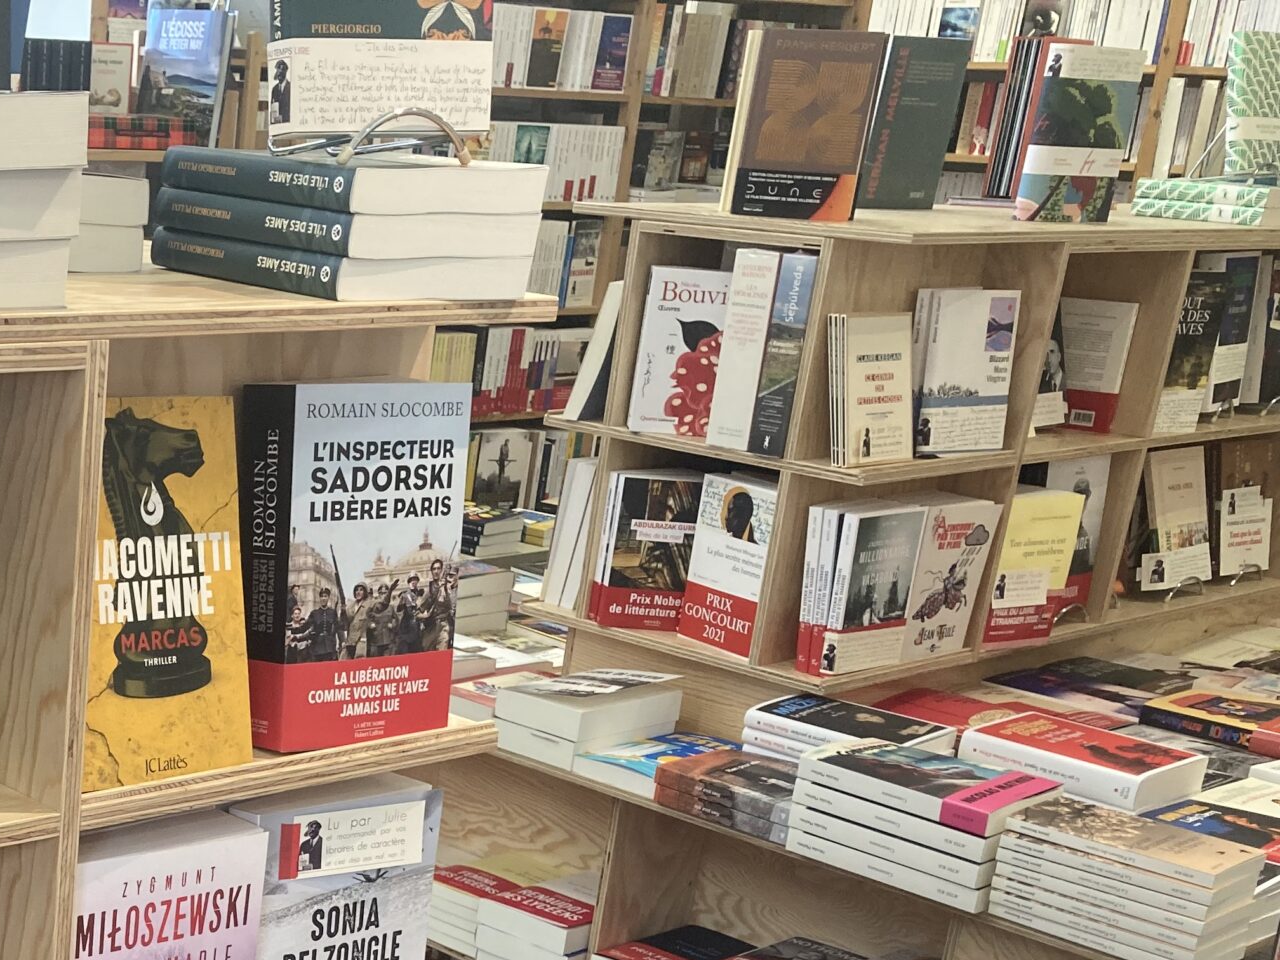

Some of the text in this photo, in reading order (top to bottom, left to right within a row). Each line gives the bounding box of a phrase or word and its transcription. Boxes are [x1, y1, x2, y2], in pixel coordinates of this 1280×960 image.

[311, 24, 382, 34] PIERGIORGIO
[866, 47, 910, 199] HERMAN MELVILLE
[269, 170, 291, 186] ÂMES
[292, 173, 309, 186] DES
[661, 281, 729, 306] Bouvi
[307, 402, 464, 419] ROMAIN SLOCOMBE
[313, 439, 455, 462] L'INSPECTEUR
[265, 429, 279, 549] SLOCOMBE
[310, 464, 454, 494] SADORSKI
[252, 460, 264, 548] ROMAIN
[309, 494, 452, 523] LIBÈRE PARIS
[94, 531, 232, 581] ACOMETTI
[97, 576, 215, 625] RAVENNE
[609, 603, 676, 617] de littérature
[630, 593, 651, 605] Prix
[706, 593, 733, 612] PRIX
[684, 602, 751, 634] GONCOURT
[703, 625, 725, 643] 2021
[143, 656, 178, 667] THRILLER
[334, 664, 409, 685] LA LIBÉRATION
[308, 679, 430, 704] COMME L'AVEZ
[381, 699, 400, 713] LUE
[121, 865, 217, 899] ZYGMUNT
[74, 884, 252, 959] MIŁOSZEWSKI
[310, 897, 380, 941] SONJA
